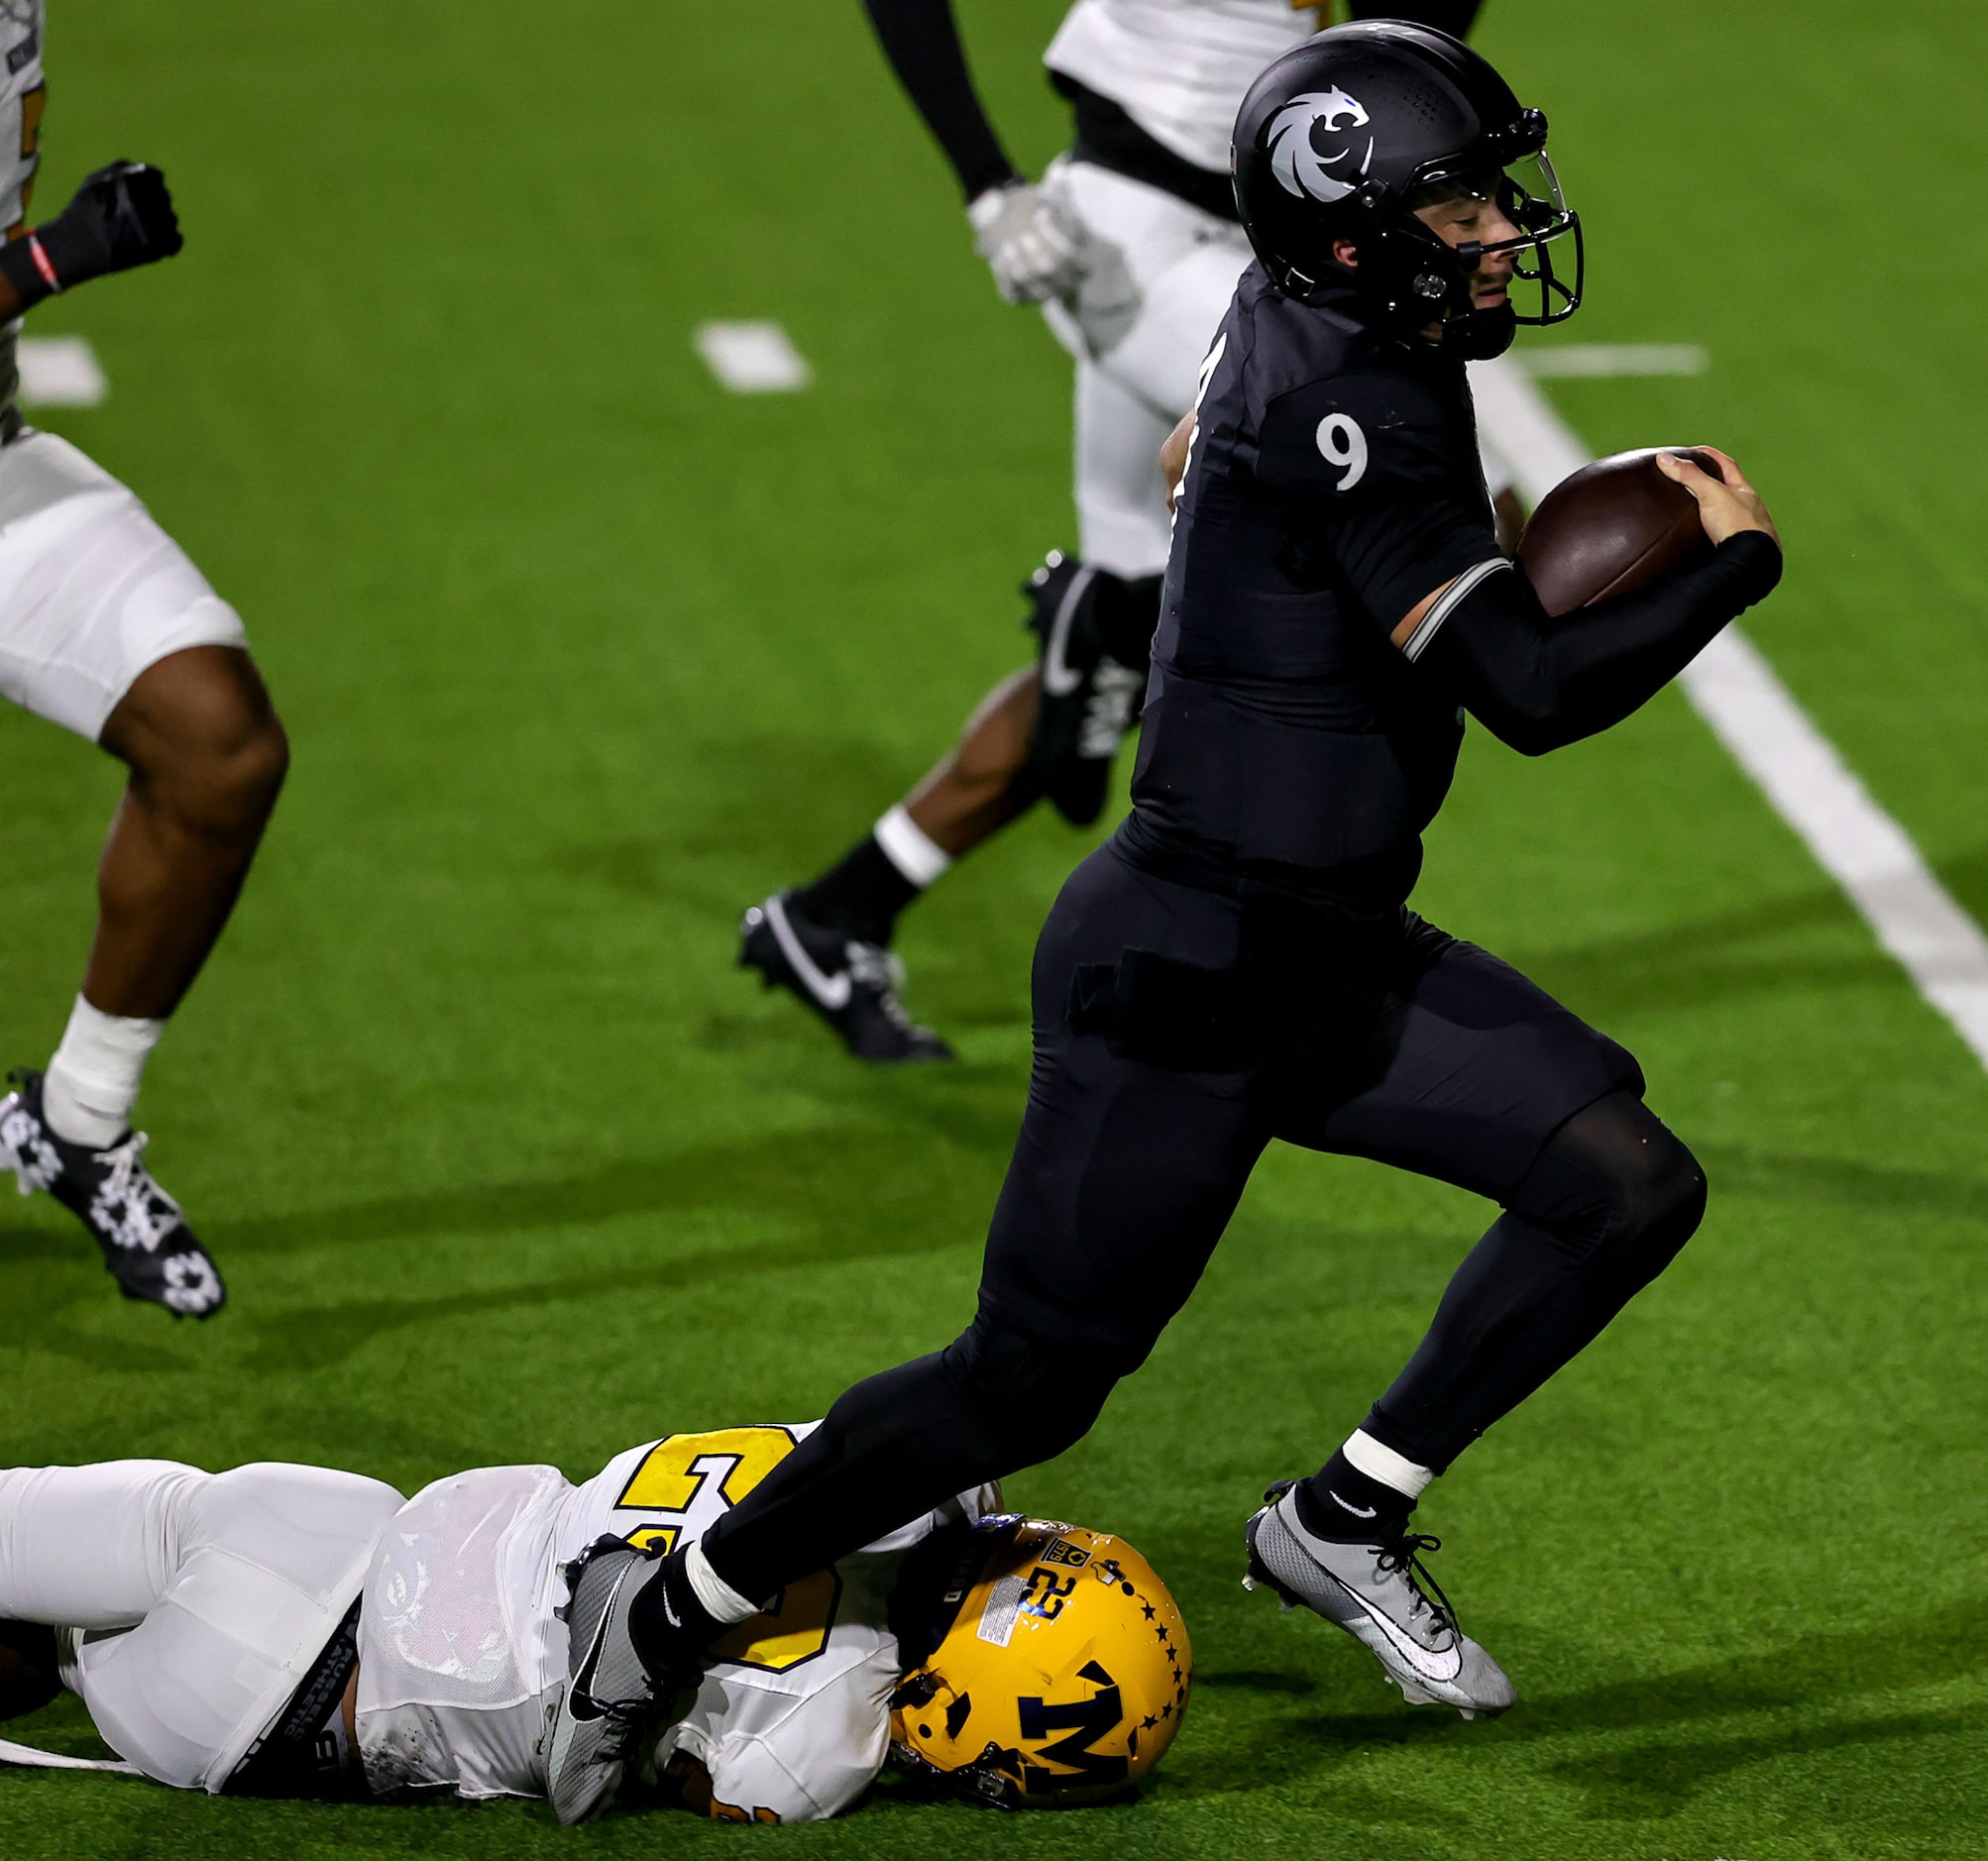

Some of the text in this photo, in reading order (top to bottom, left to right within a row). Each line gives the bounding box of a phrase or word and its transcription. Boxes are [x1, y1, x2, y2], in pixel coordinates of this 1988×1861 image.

[1316, 412, 1368, 492] 9
[1049, 1541, 1071, 1562] 1979
[1017, 1566, 1076, 1620] 23
[284, 1644, 343, 1736] ATHLETIC
[1018, 1684, 1129, 1798] M
